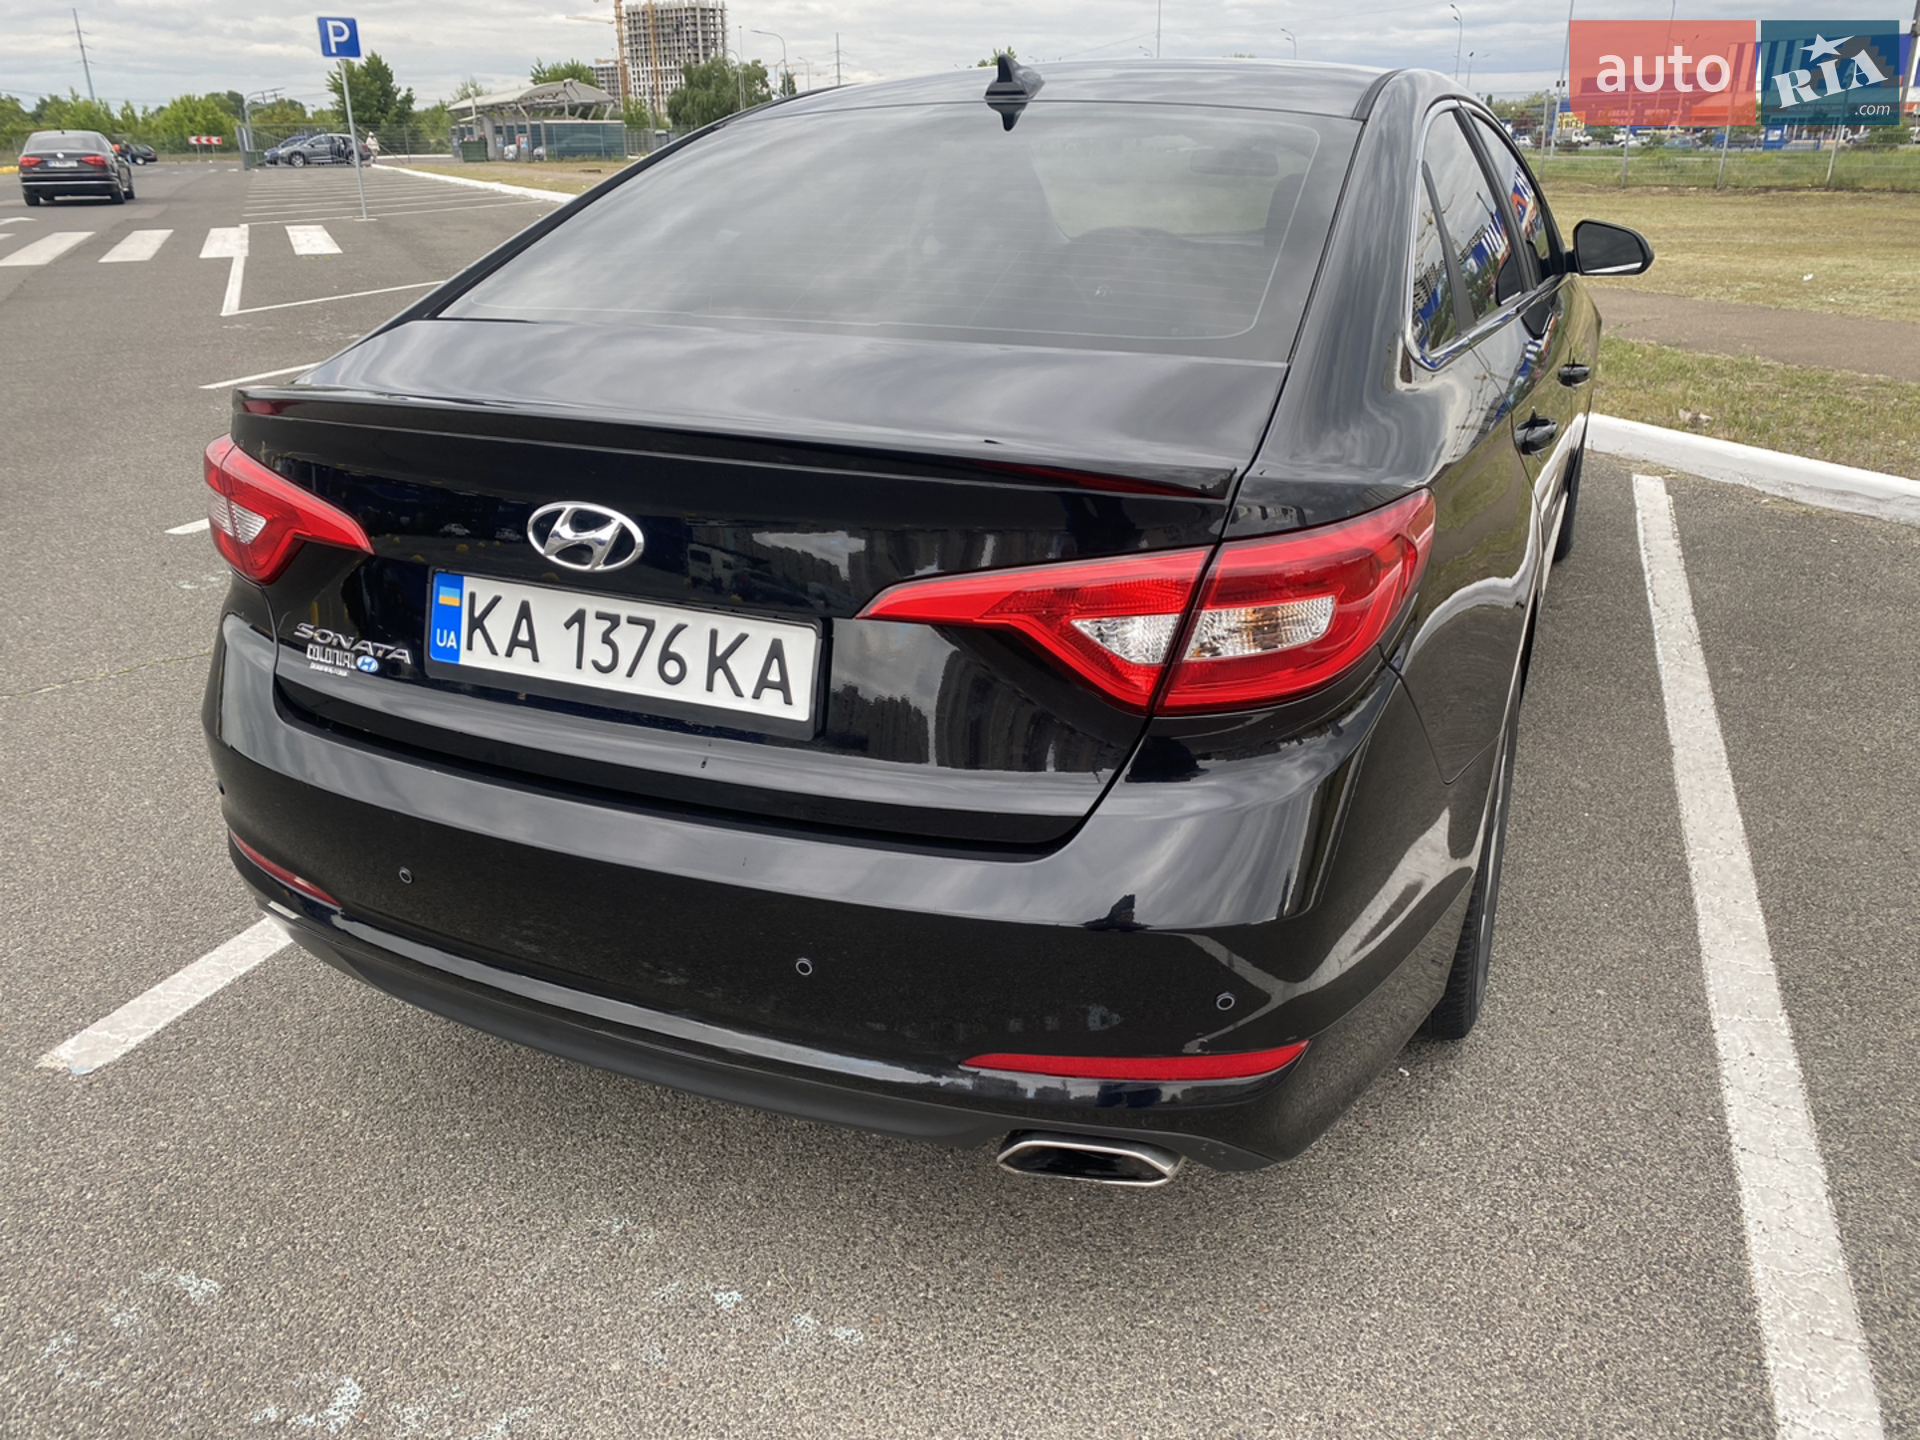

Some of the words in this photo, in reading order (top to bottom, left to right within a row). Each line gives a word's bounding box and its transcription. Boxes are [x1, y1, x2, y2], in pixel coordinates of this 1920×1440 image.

[326, 20, 350, 54] P
[293, 622, 412, 665] SONATA
[306, 643, 357, 670] COLONIAL
[437, 629, 458, 650] UA
[466, 591, 540, 663] KA
[564, 608, 688, 686] 1376
[706, 628, 793, 706] KA
